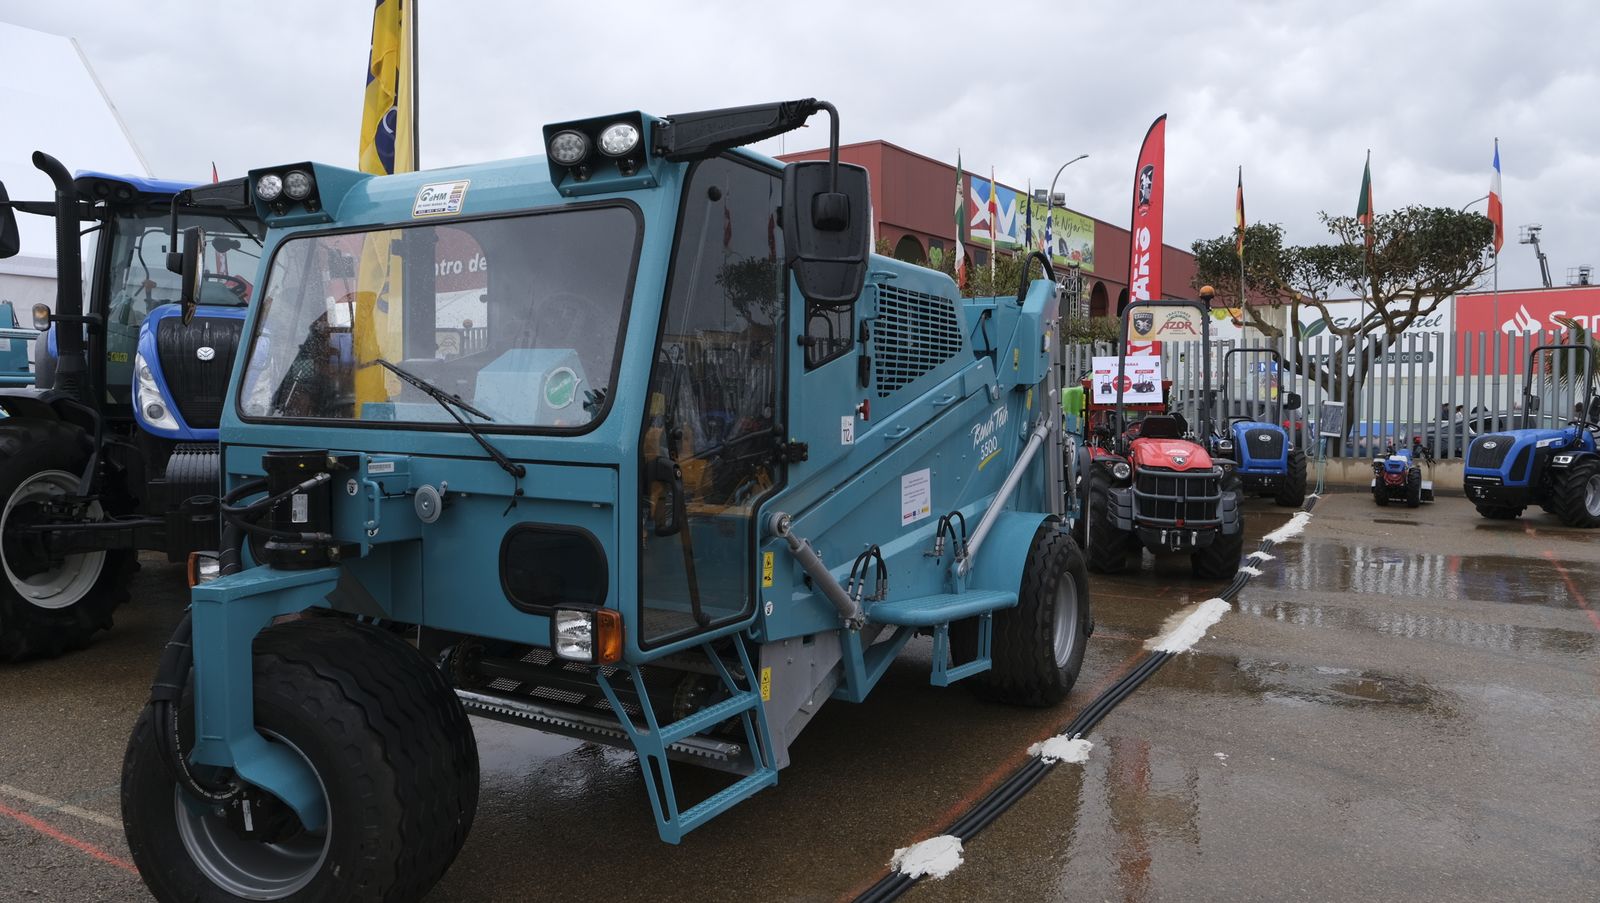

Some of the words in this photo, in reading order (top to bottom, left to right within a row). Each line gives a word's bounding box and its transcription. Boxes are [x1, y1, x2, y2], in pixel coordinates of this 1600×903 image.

[468, 253, 487, 273] de
[1156, 320, 1197, 335] AZOR
[980, 436, 998, 460] 5500
